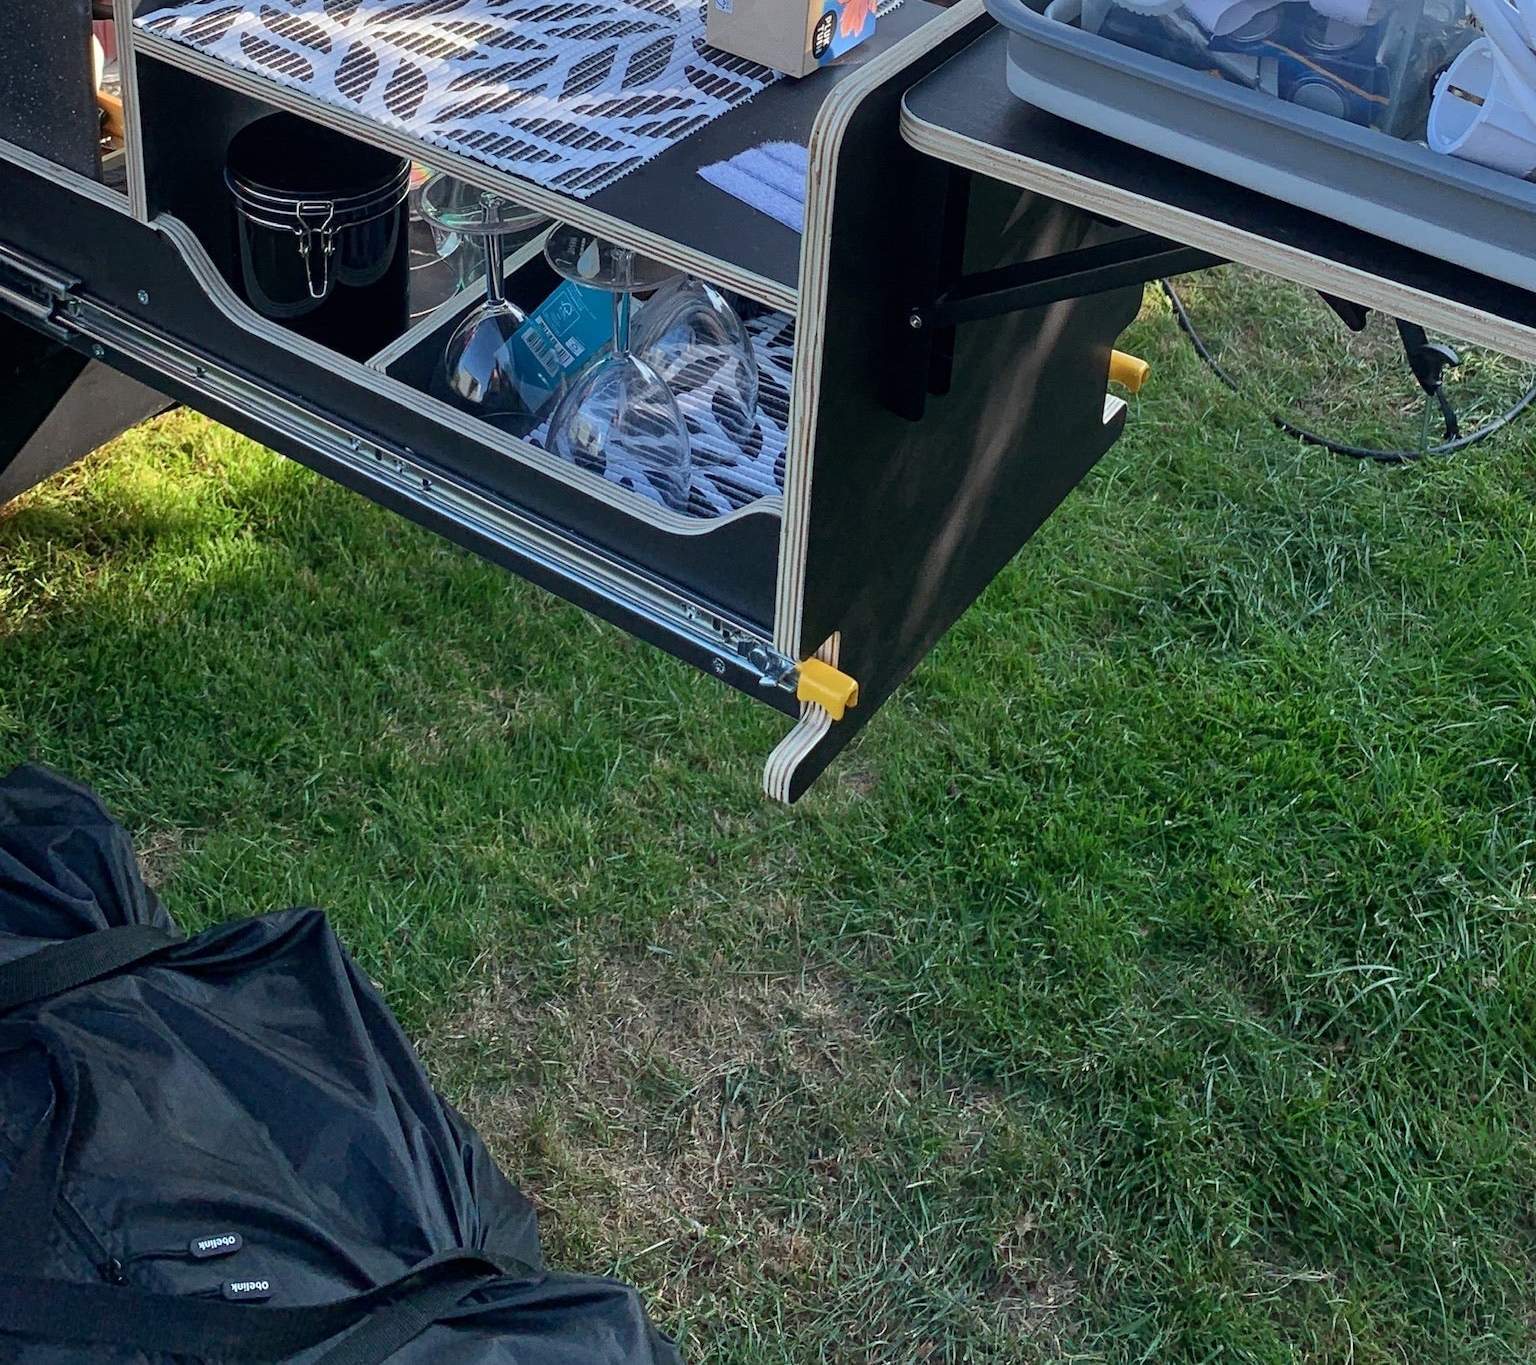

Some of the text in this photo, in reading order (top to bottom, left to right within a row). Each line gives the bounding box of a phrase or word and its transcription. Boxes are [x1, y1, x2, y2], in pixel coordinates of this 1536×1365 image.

[823, 15, 832, 47] PLUK
[198, 1235, 236, 1251] Obelink
[230, 1280, 269, 1293] Obelink
